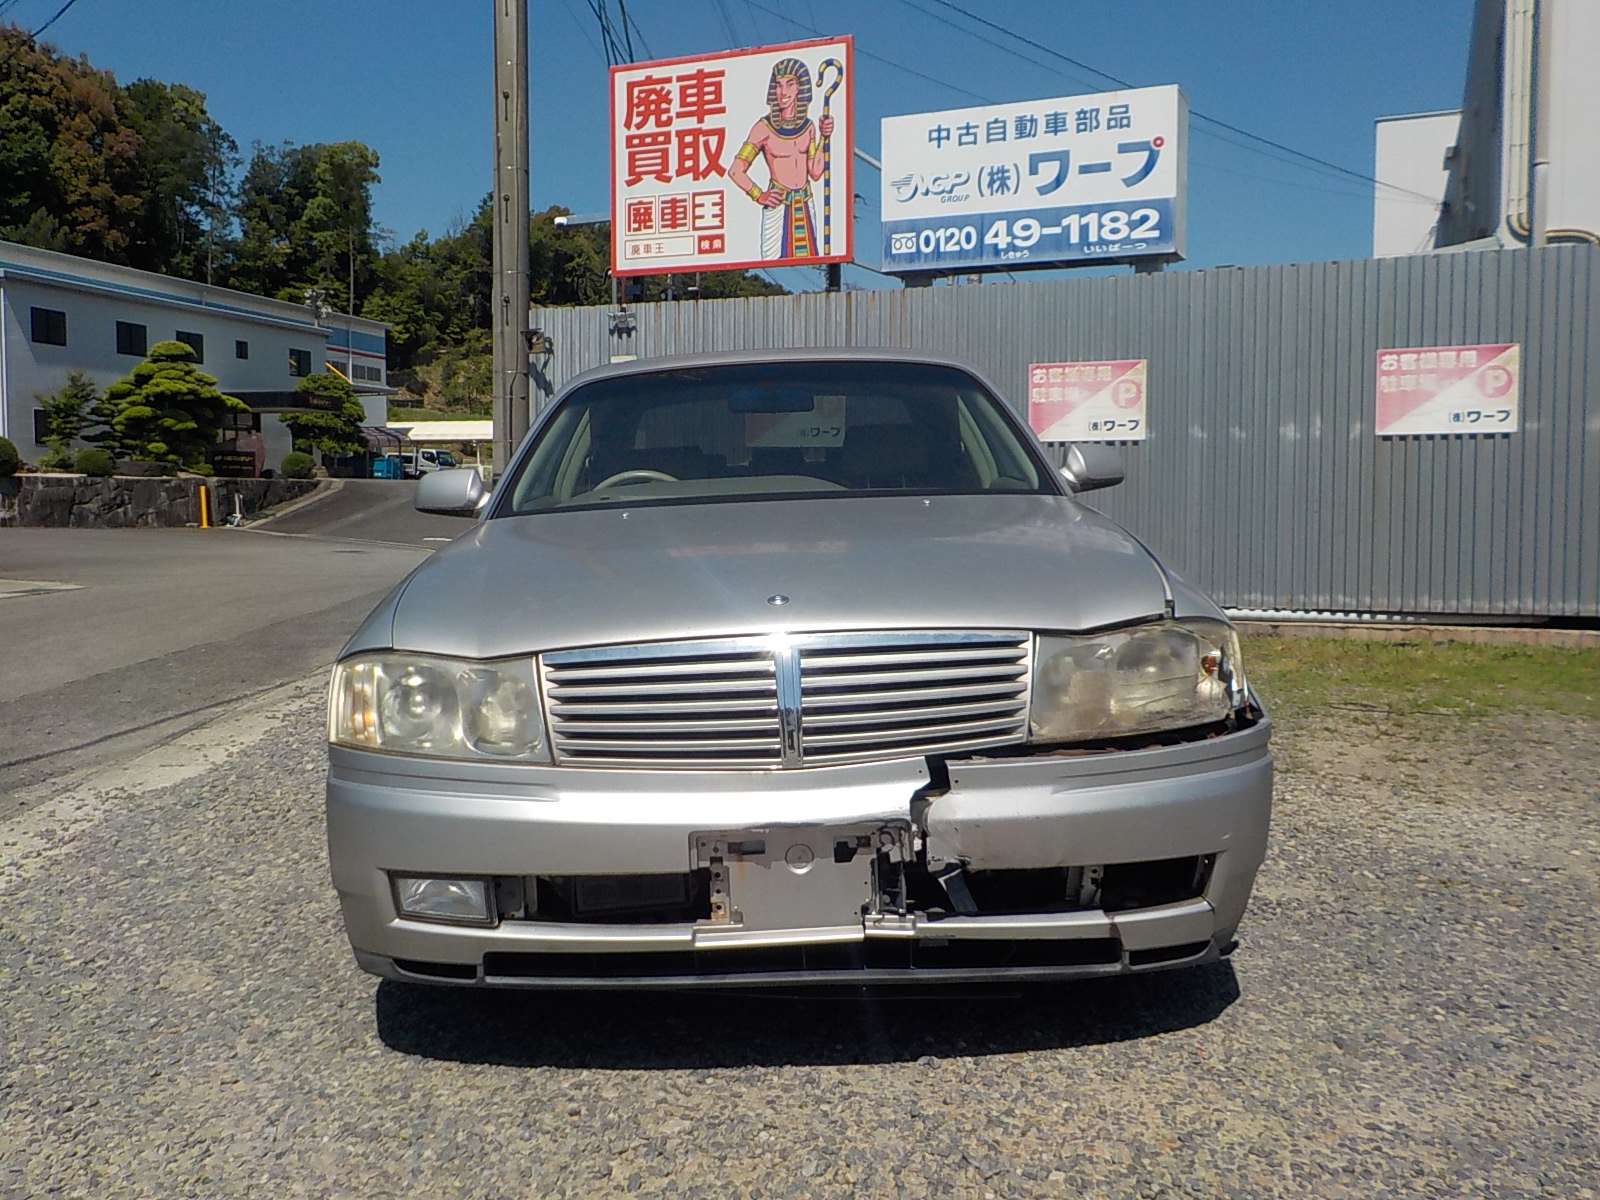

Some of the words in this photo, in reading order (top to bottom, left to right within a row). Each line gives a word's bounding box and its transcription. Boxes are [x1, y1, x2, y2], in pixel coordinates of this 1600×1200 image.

[623, 68, 727, 131] 廃車
[928, 103, 1132, 149] 中古自動車部品
[624, 127, 727, 187] 買取
[940, 194, 970, 204] GROUP
[919, 225, 977, 252] 0120
[984, 208, 1160, 249] 49-1182
